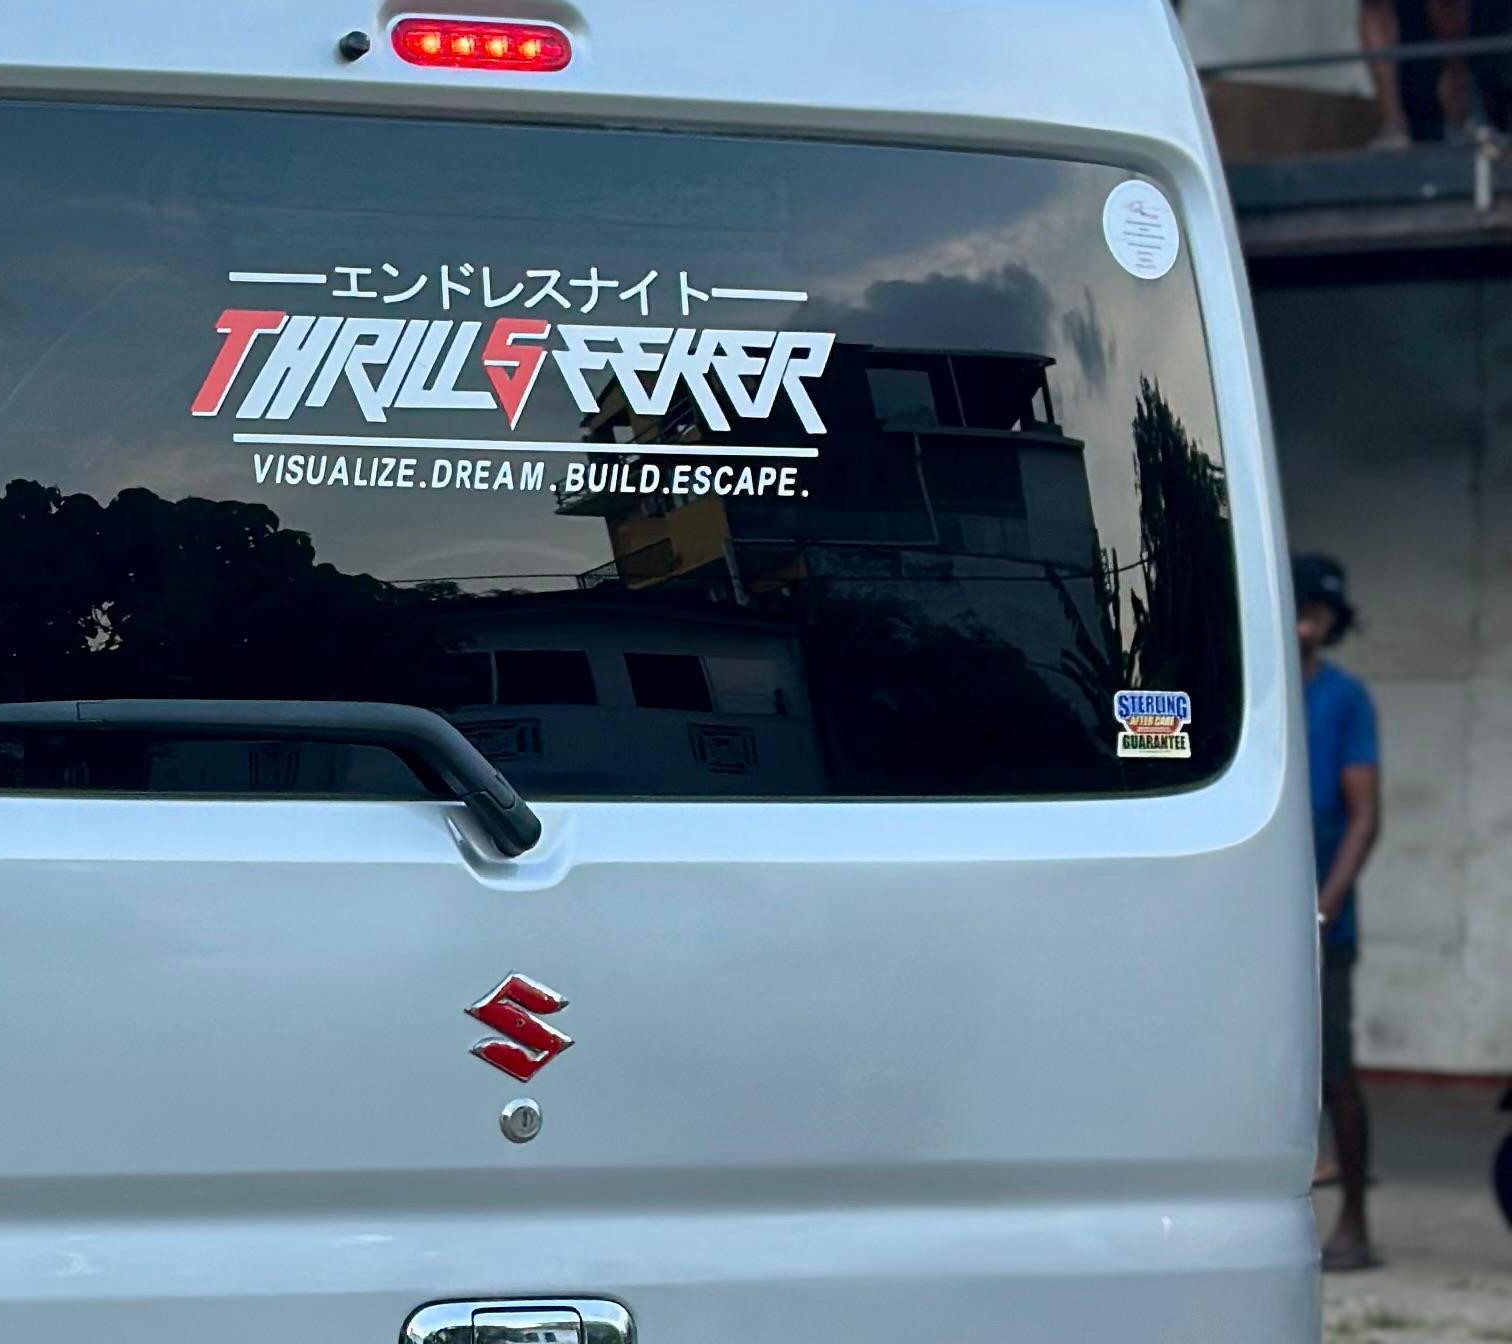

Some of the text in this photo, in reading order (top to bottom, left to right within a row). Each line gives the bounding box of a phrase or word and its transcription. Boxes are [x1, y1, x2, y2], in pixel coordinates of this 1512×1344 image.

[332, 262, 710, 316] エンドレスナイト
[1118, 695, 1187, 719] STERLING
[1122, 734, 1187, 750] GUARANTEE
